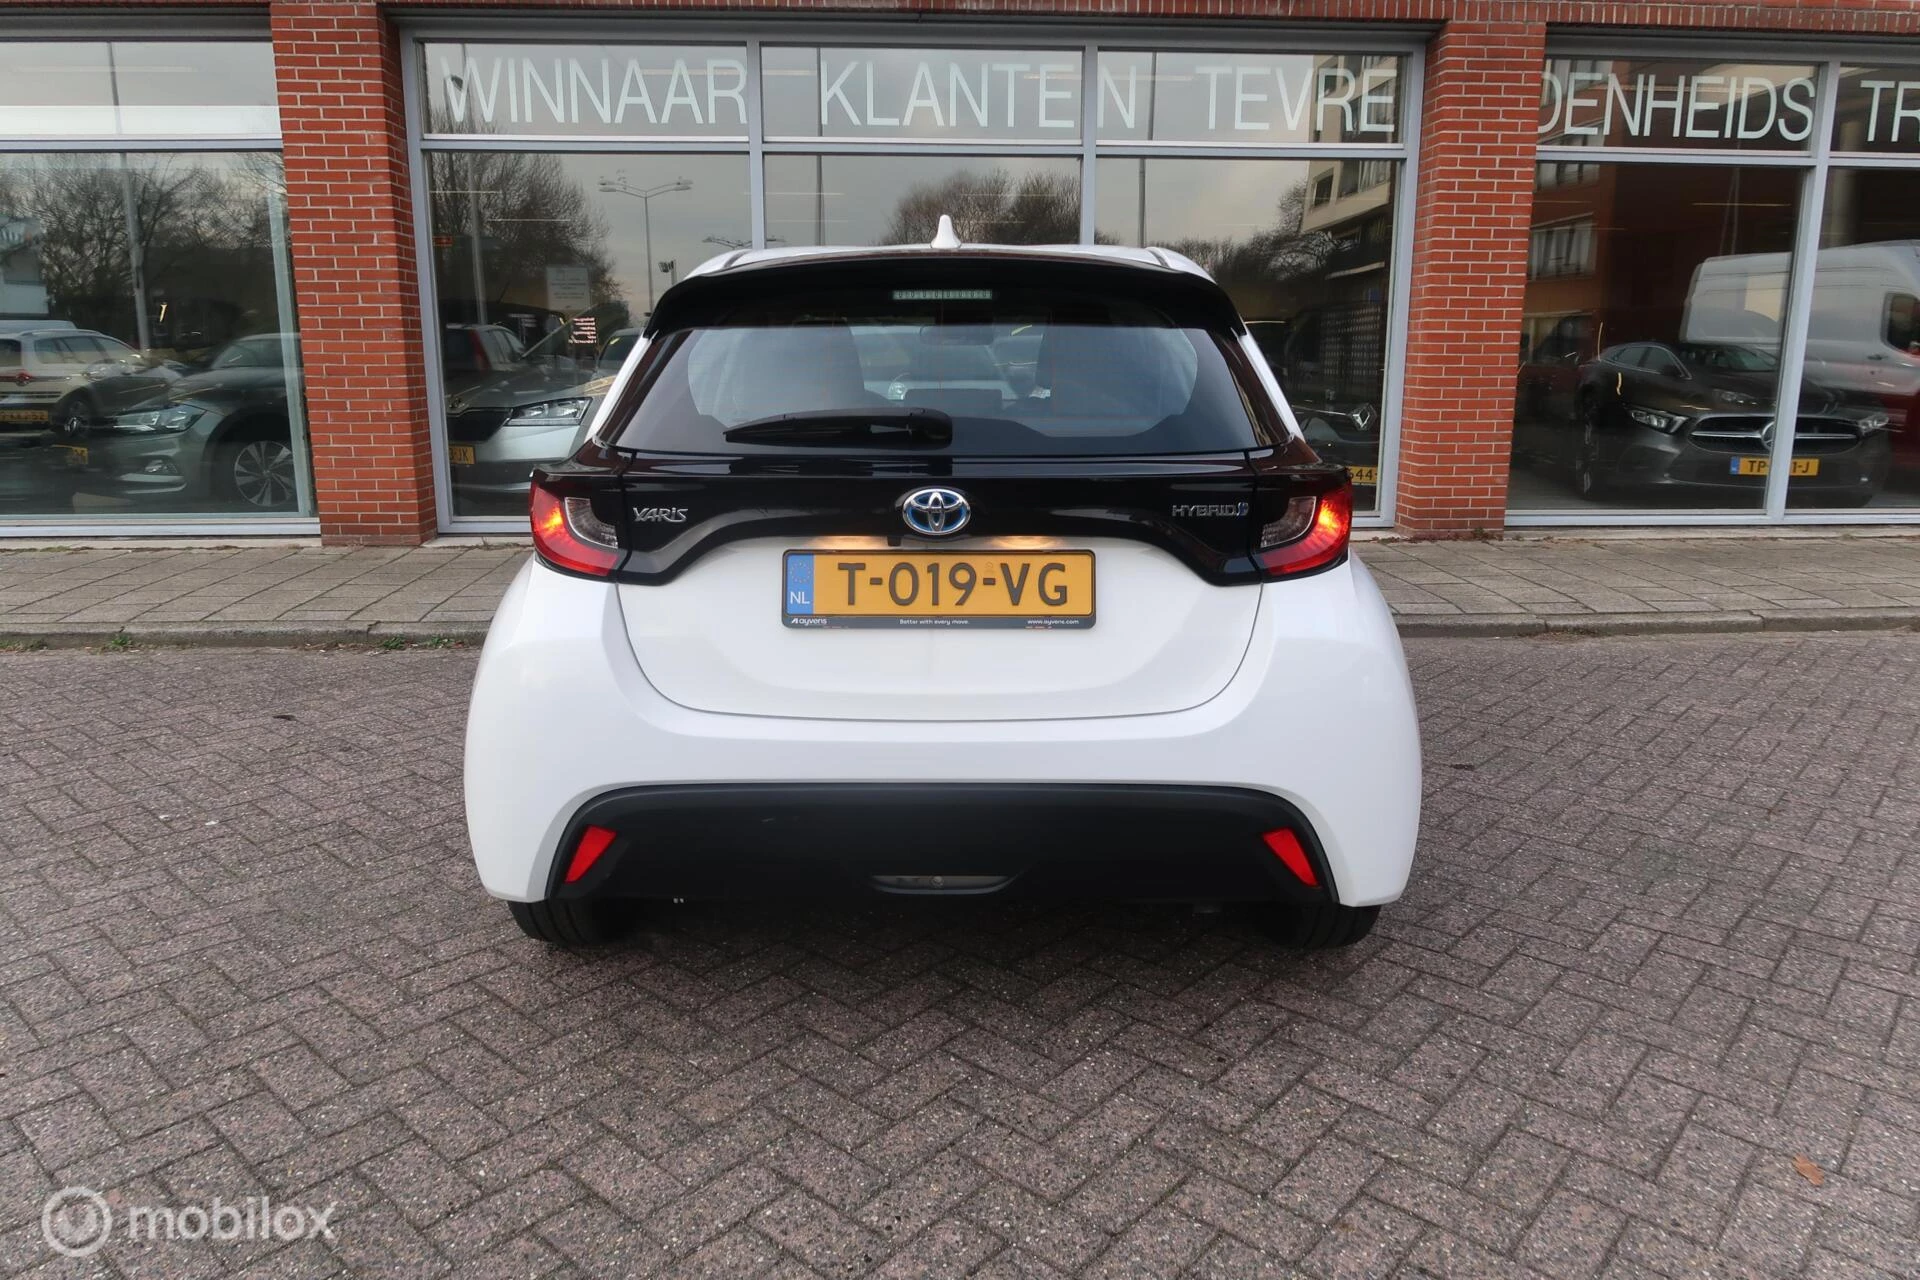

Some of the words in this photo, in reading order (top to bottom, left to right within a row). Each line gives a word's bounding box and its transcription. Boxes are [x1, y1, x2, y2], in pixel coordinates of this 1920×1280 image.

[440, 55, 748, 125] WINNAAR
[820, 61, 1137, 129] KLANTEN
[1196, 65, 1397, 133] TEVRE
[1172, 504, 1236, 517] HYBRID
[790, 591, 810, 604] NL
[838, 562, 1068, 606] T-019-VG
